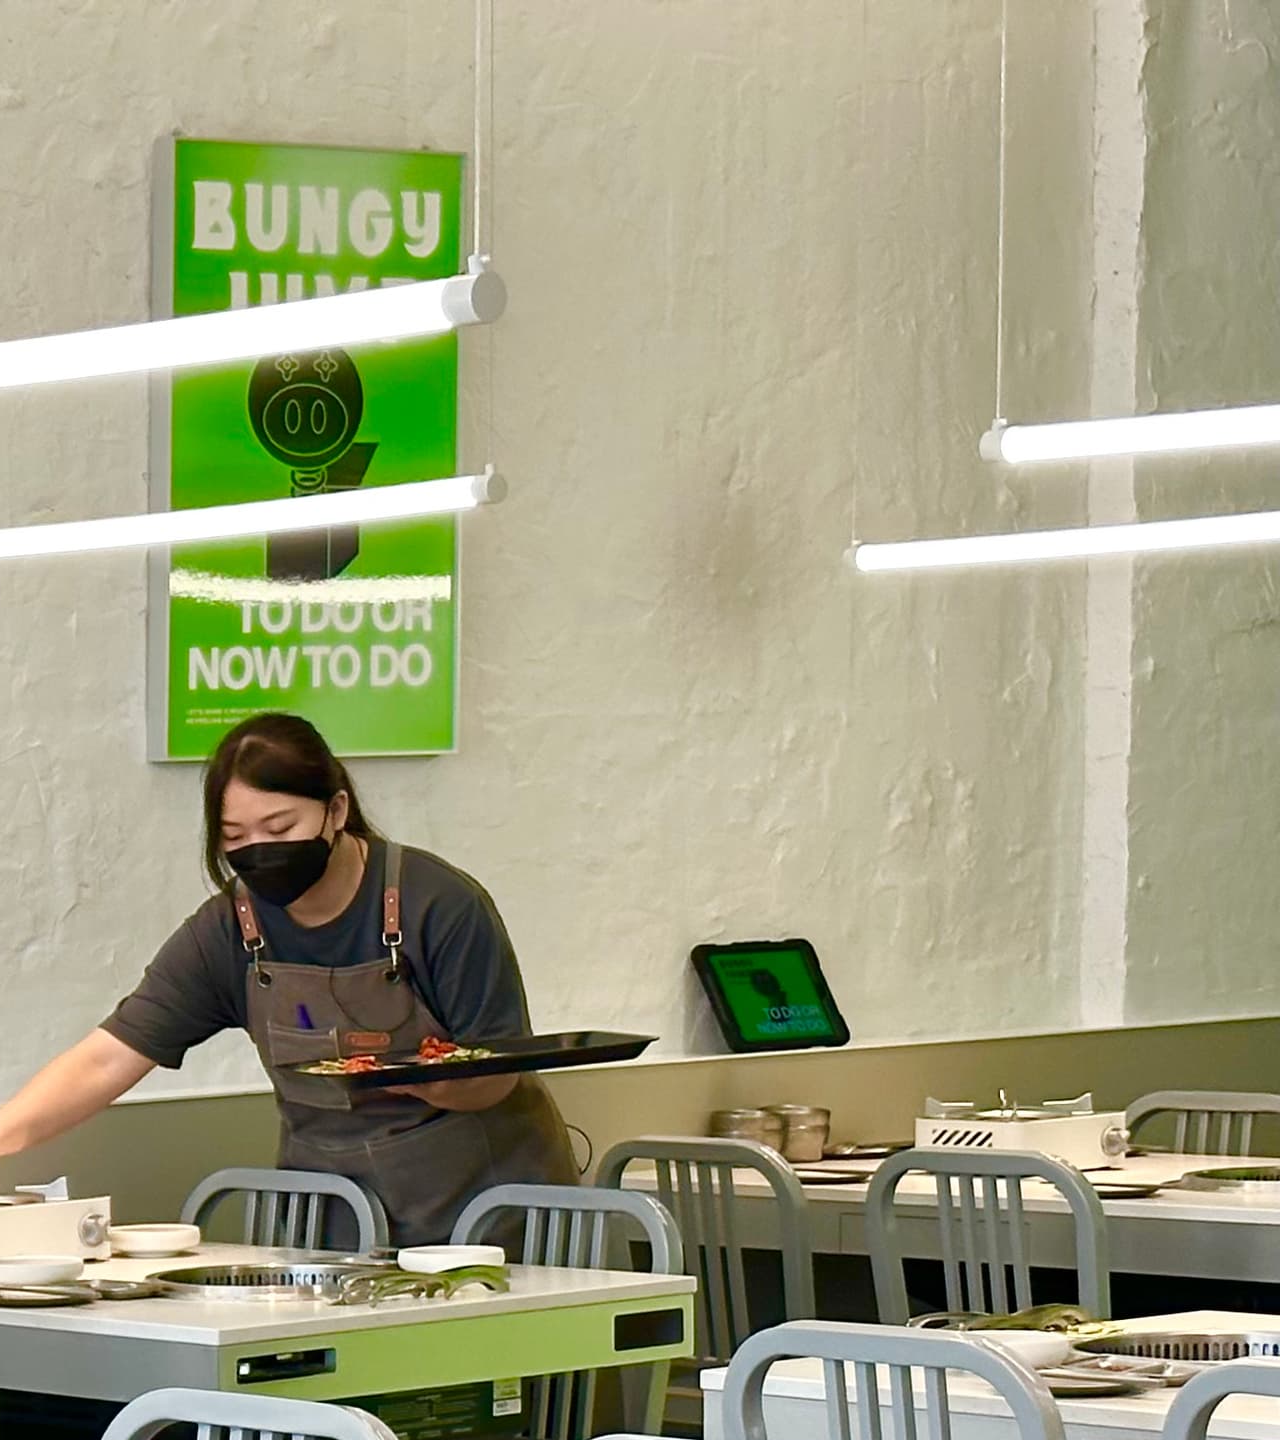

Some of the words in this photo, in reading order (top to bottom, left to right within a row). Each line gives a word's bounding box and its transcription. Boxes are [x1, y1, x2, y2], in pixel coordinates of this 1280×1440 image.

[192, 181, 442, 258] BUNGY
[240, 598, 291, 634] TO
[301, 598, 355, 633] DO
[371, 596, 433, 632] OR
[188, 646, 298, 690] NOW
[302, 645, 361, 688] TO
[370, 643, 432, 687] DO
